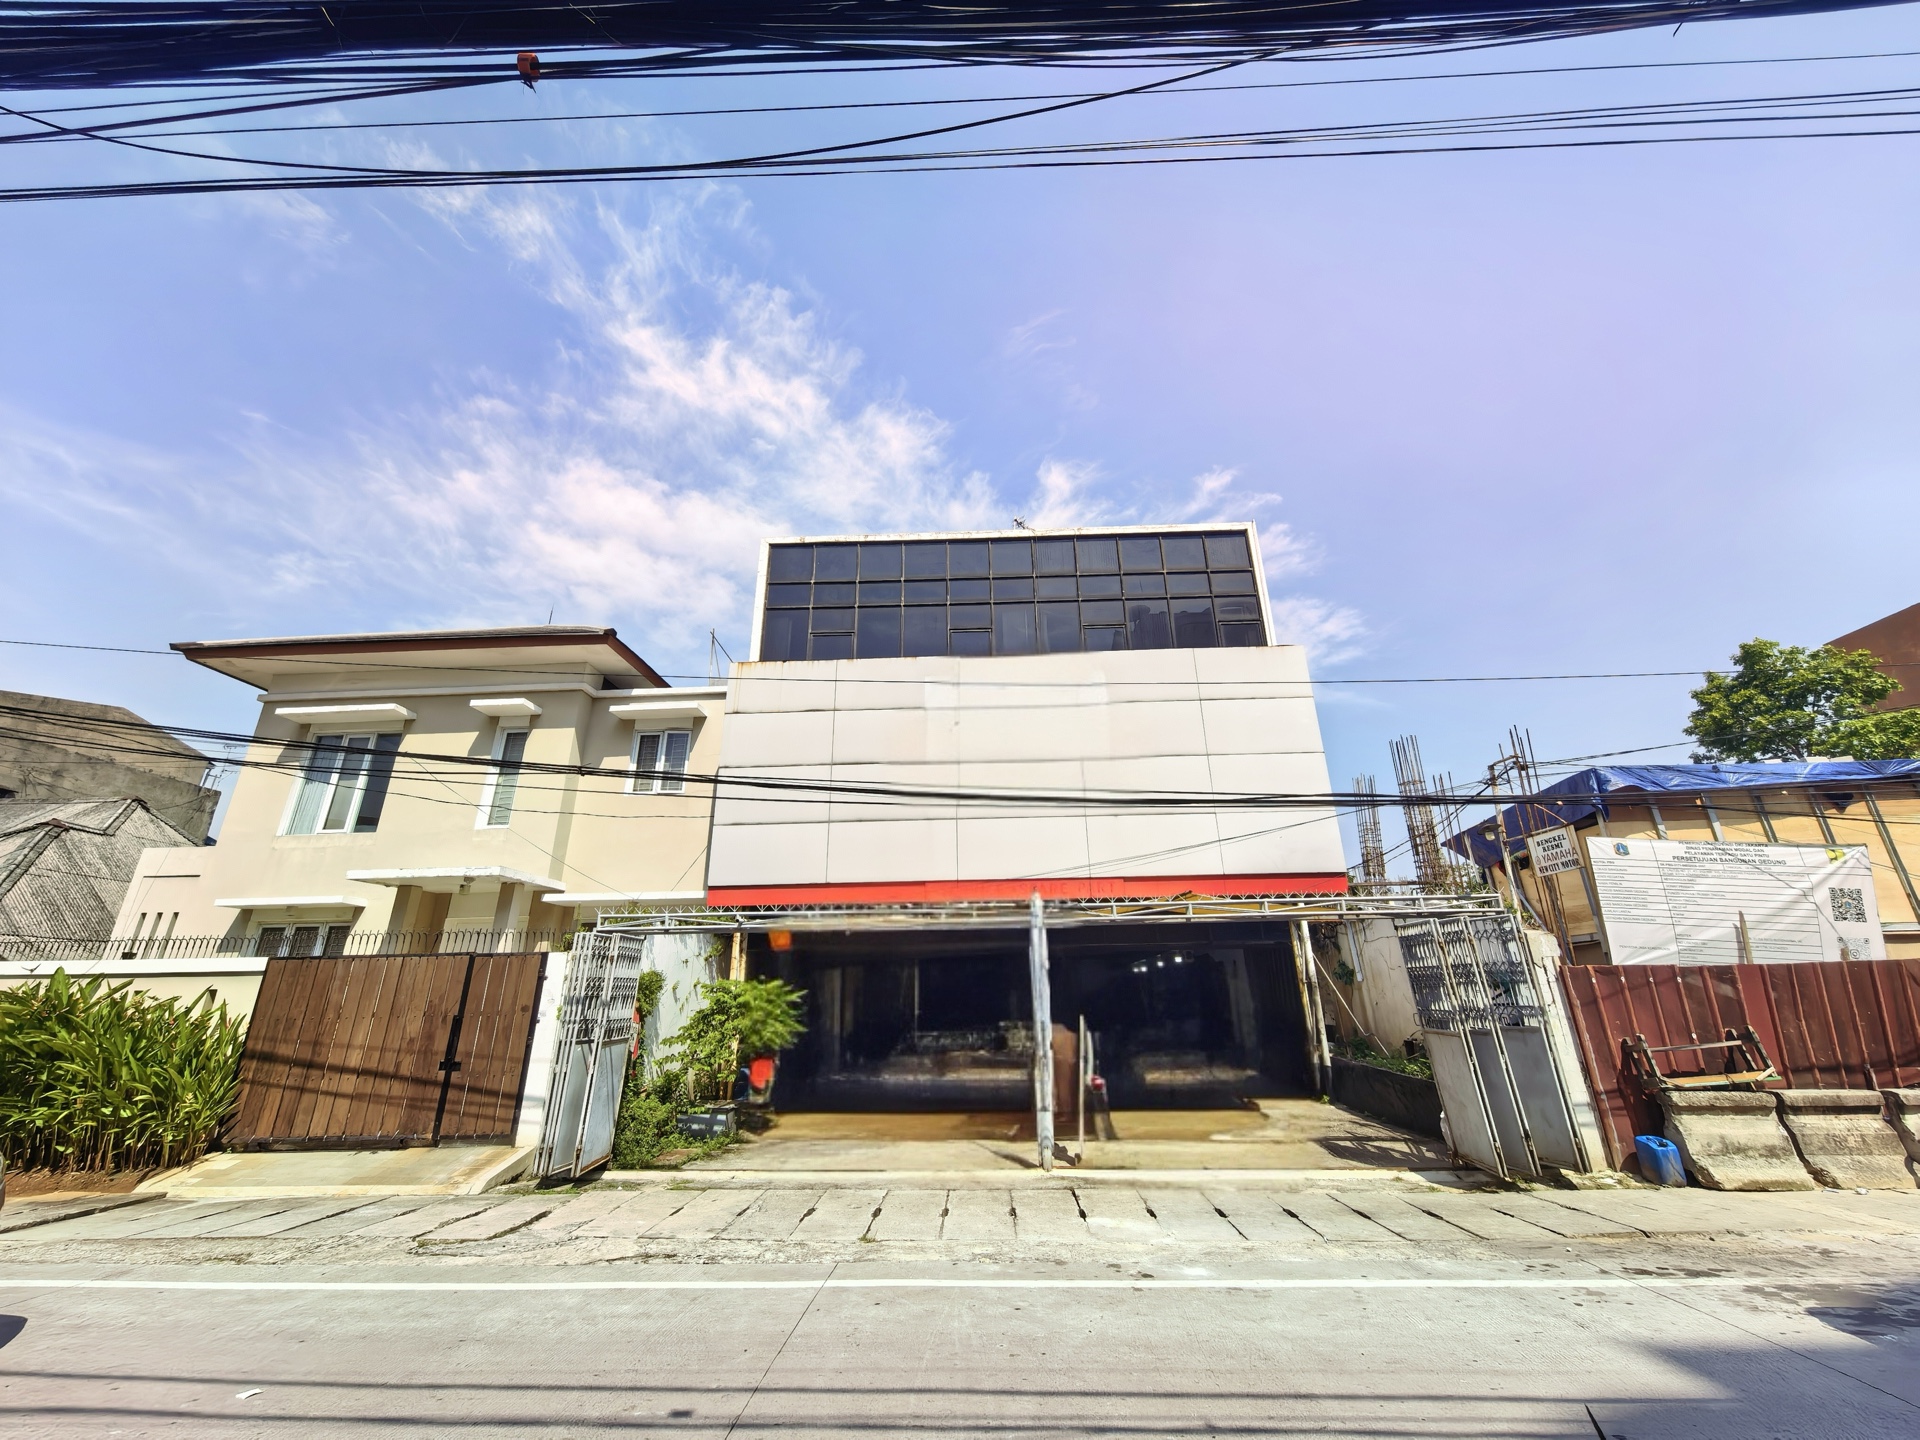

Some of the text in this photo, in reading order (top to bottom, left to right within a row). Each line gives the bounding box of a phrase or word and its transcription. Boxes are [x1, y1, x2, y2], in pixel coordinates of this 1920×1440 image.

[1536, 834, 1566, 847] BENGKEL
[1542, 842, 1564, 852] RESMI
[1541, 847, 1579, 863] YAMAHA
[1672, 855, 1719, 863] PERSETUJUAN
[1538, 864, 1550, 874] NEW
[1549, 862, 1561, 873] CITY
[1560, 857, 1581, 870] MOTOR
